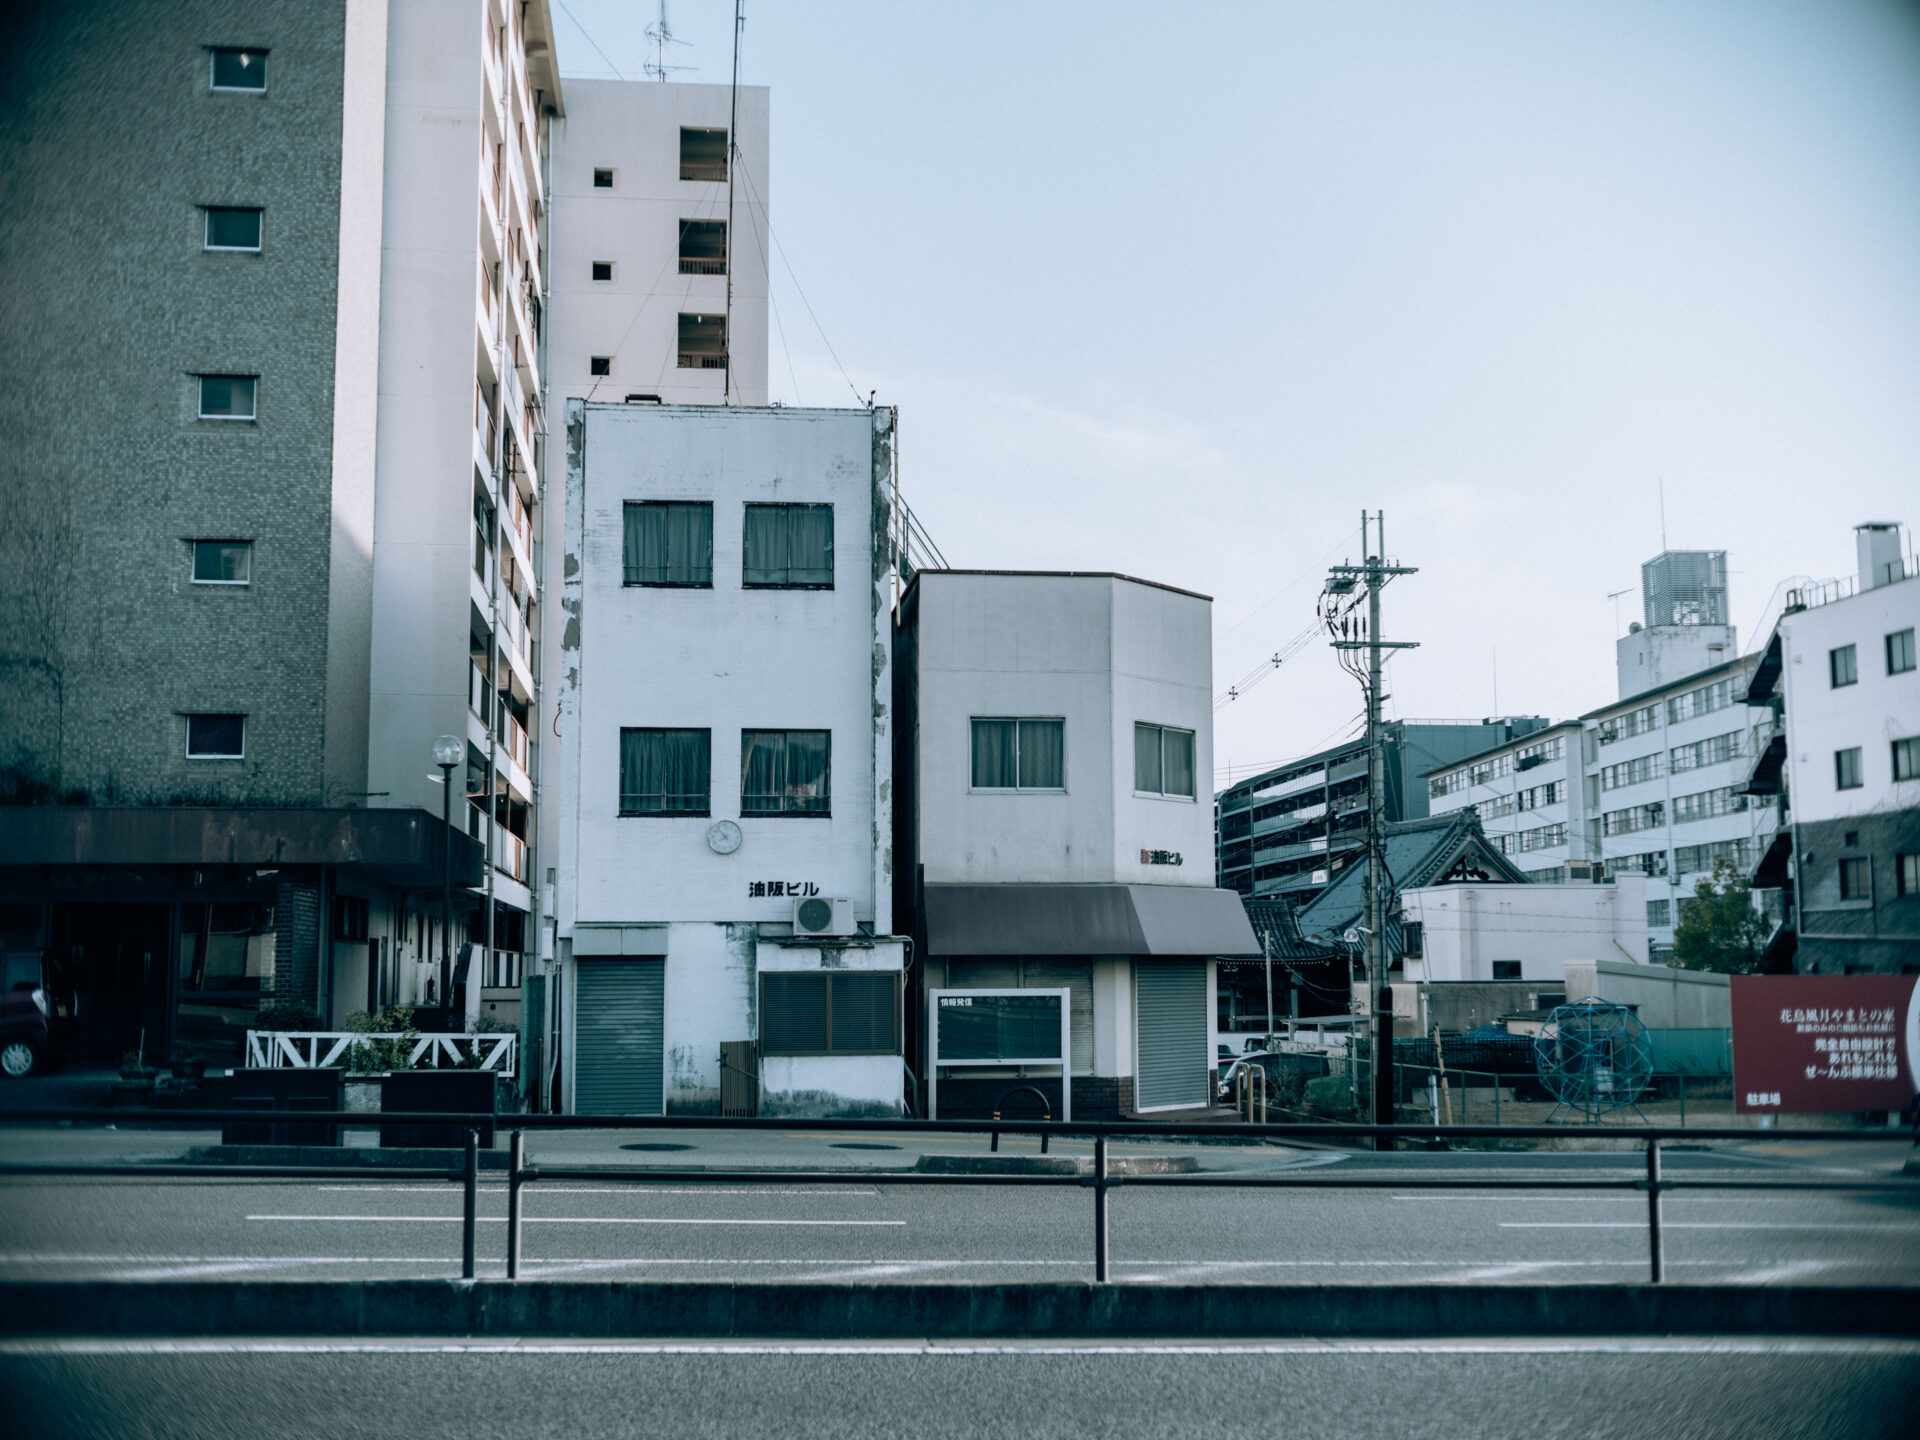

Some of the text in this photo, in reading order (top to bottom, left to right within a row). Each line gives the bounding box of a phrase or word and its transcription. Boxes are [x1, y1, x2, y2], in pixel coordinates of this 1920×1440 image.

[748, 881, 820, 898] 油阪ビル
[940, 997, 973, 1007] 情報発信
[1814, 1037, 1896, 1052] 完全自由設計で
[1828, 1052, 1898, 1065] あれもこれも
[1746, 1092, 1782, 1106] 駐車場
